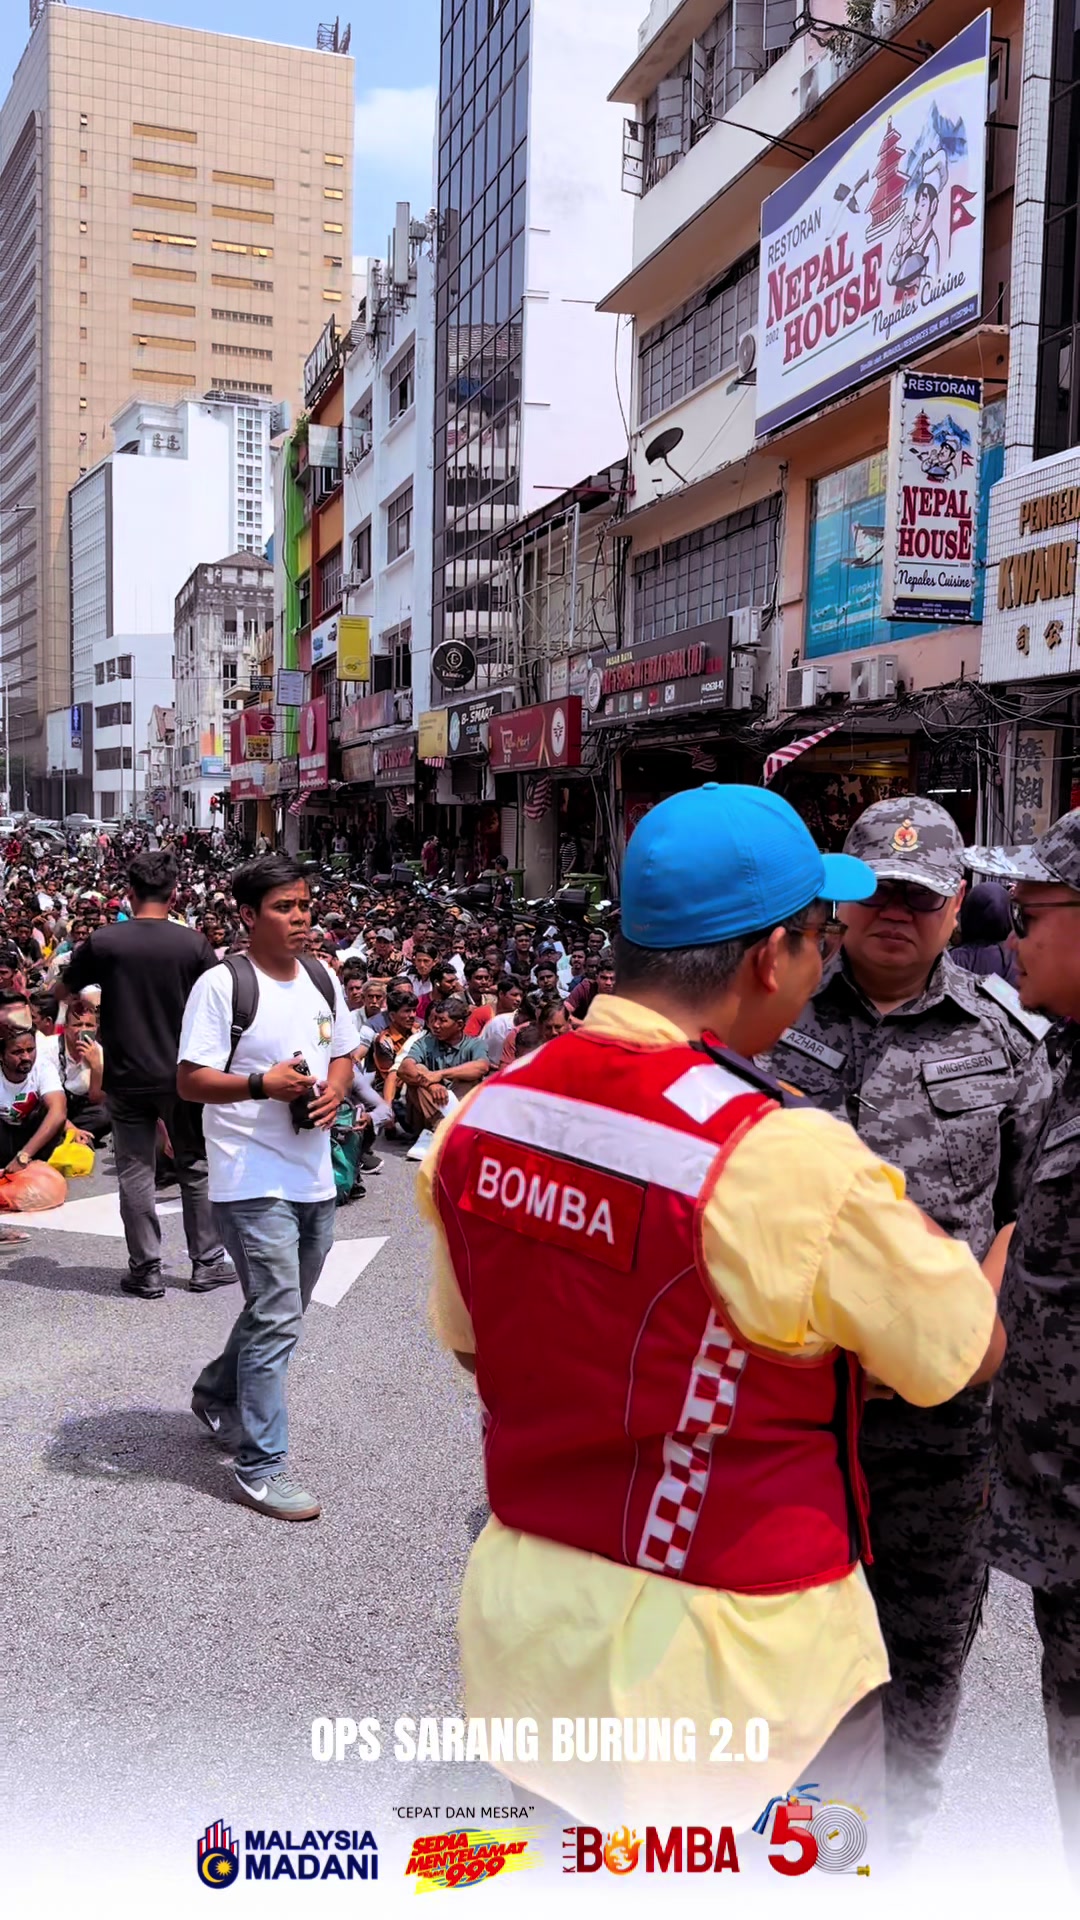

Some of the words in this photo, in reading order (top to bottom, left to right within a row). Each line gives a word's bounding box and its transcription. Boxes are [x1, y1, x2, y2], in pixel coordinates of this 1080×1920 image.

[768, 207, 822, 267] RESTORAN
[766, 232, 854, 329] NEPAL
[783, 242, 883, 365] HOUSE
[872, 301, 918, 341] Nepales
[921, 271, 966, 307] Cuisine
[765, 327, 780, 347] 2002
[908, 378, 975, 396] RESTORAN
[901, 485, 972, 526] NEPAL
[898, 520, 972, 560] HOUSE
[898, 569, 937, 592] Nepales
[938, 572, 971, 588] Cuisine
[998, 539, 1077, 611] KWANG
[786, 1032, 825, 1056] AZHAR
[936, 1055, 993, 1076] IMIGRESEN
[477, 1156, 615, 1245] BOMBA
